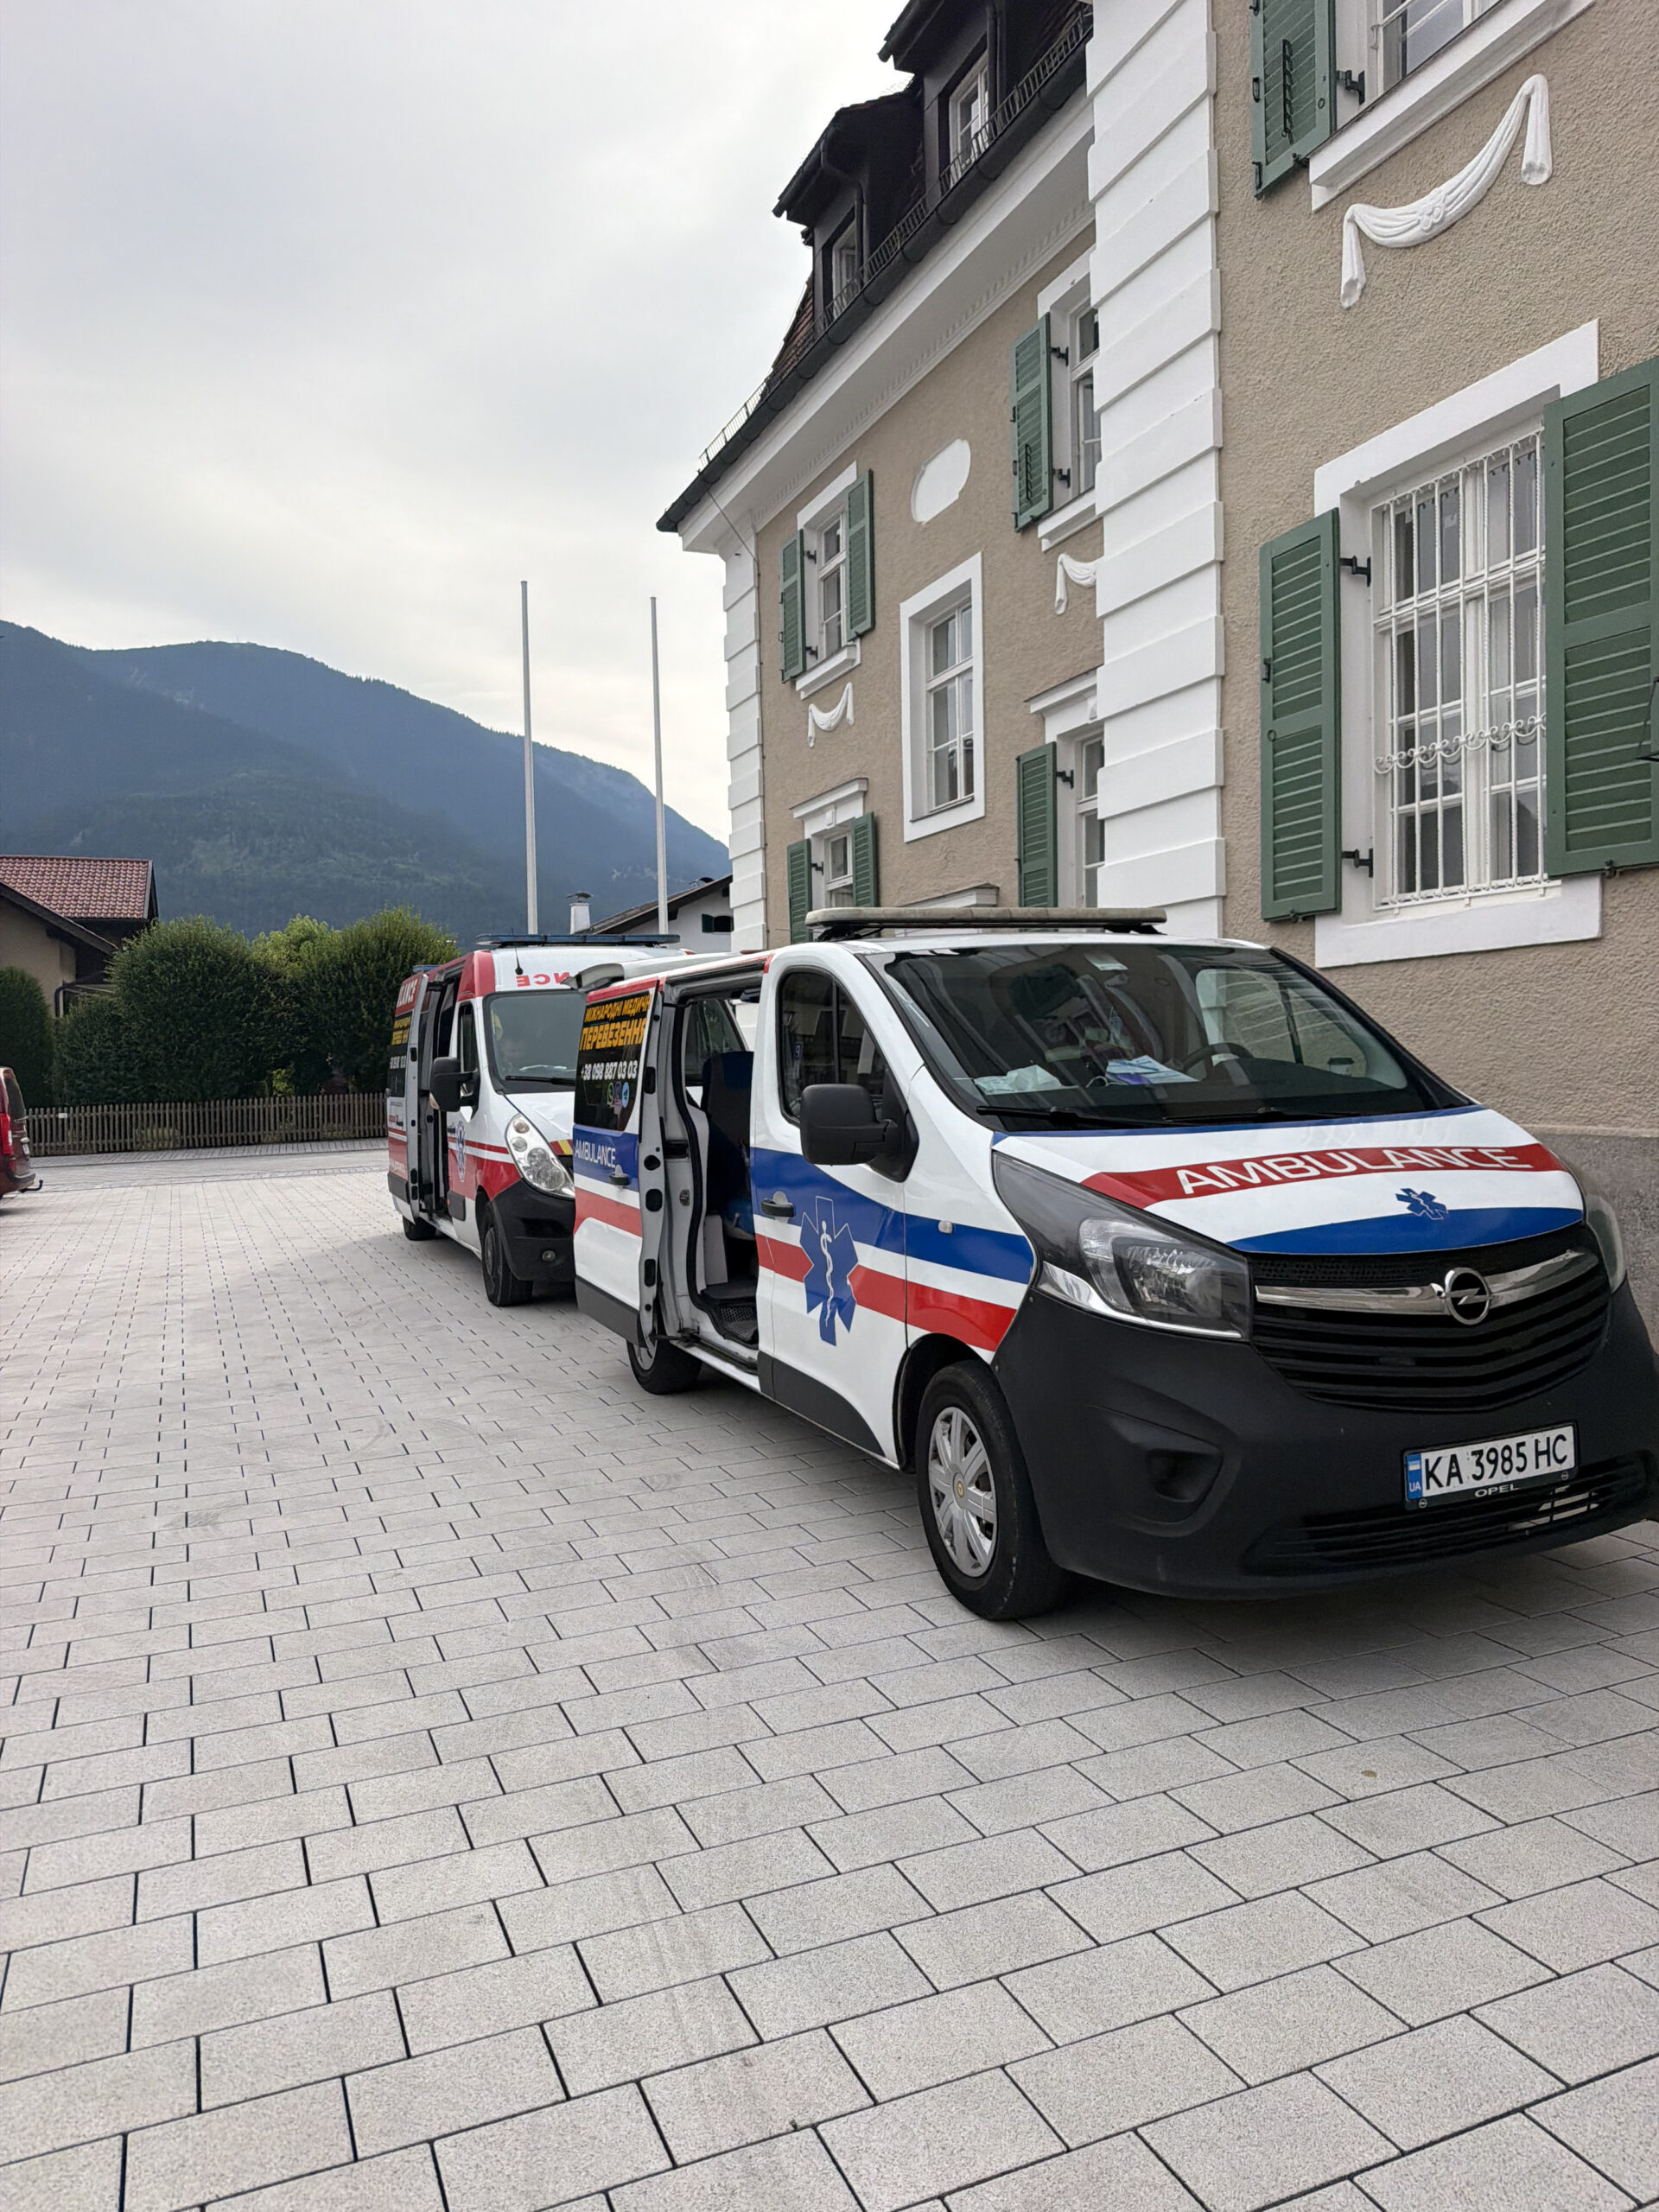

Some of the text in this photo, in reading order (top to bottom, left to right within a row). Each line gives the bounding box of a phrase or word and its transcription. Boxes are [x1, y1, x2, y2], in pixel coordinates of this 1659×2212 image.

[617, 1060, 627, 1079] 03
[627, 1060, 638, 1079] 03
[575, 1139, 616, 1168] AMBULANCE
[1176, 1147, 1534, 1195] AMBULANCE
[1426, 1434, 1567, 1491] KA 3985 HC
[1409, 1482, 1421, 1492] UA
[1474, 1484, 1520, 1497] OPEL
